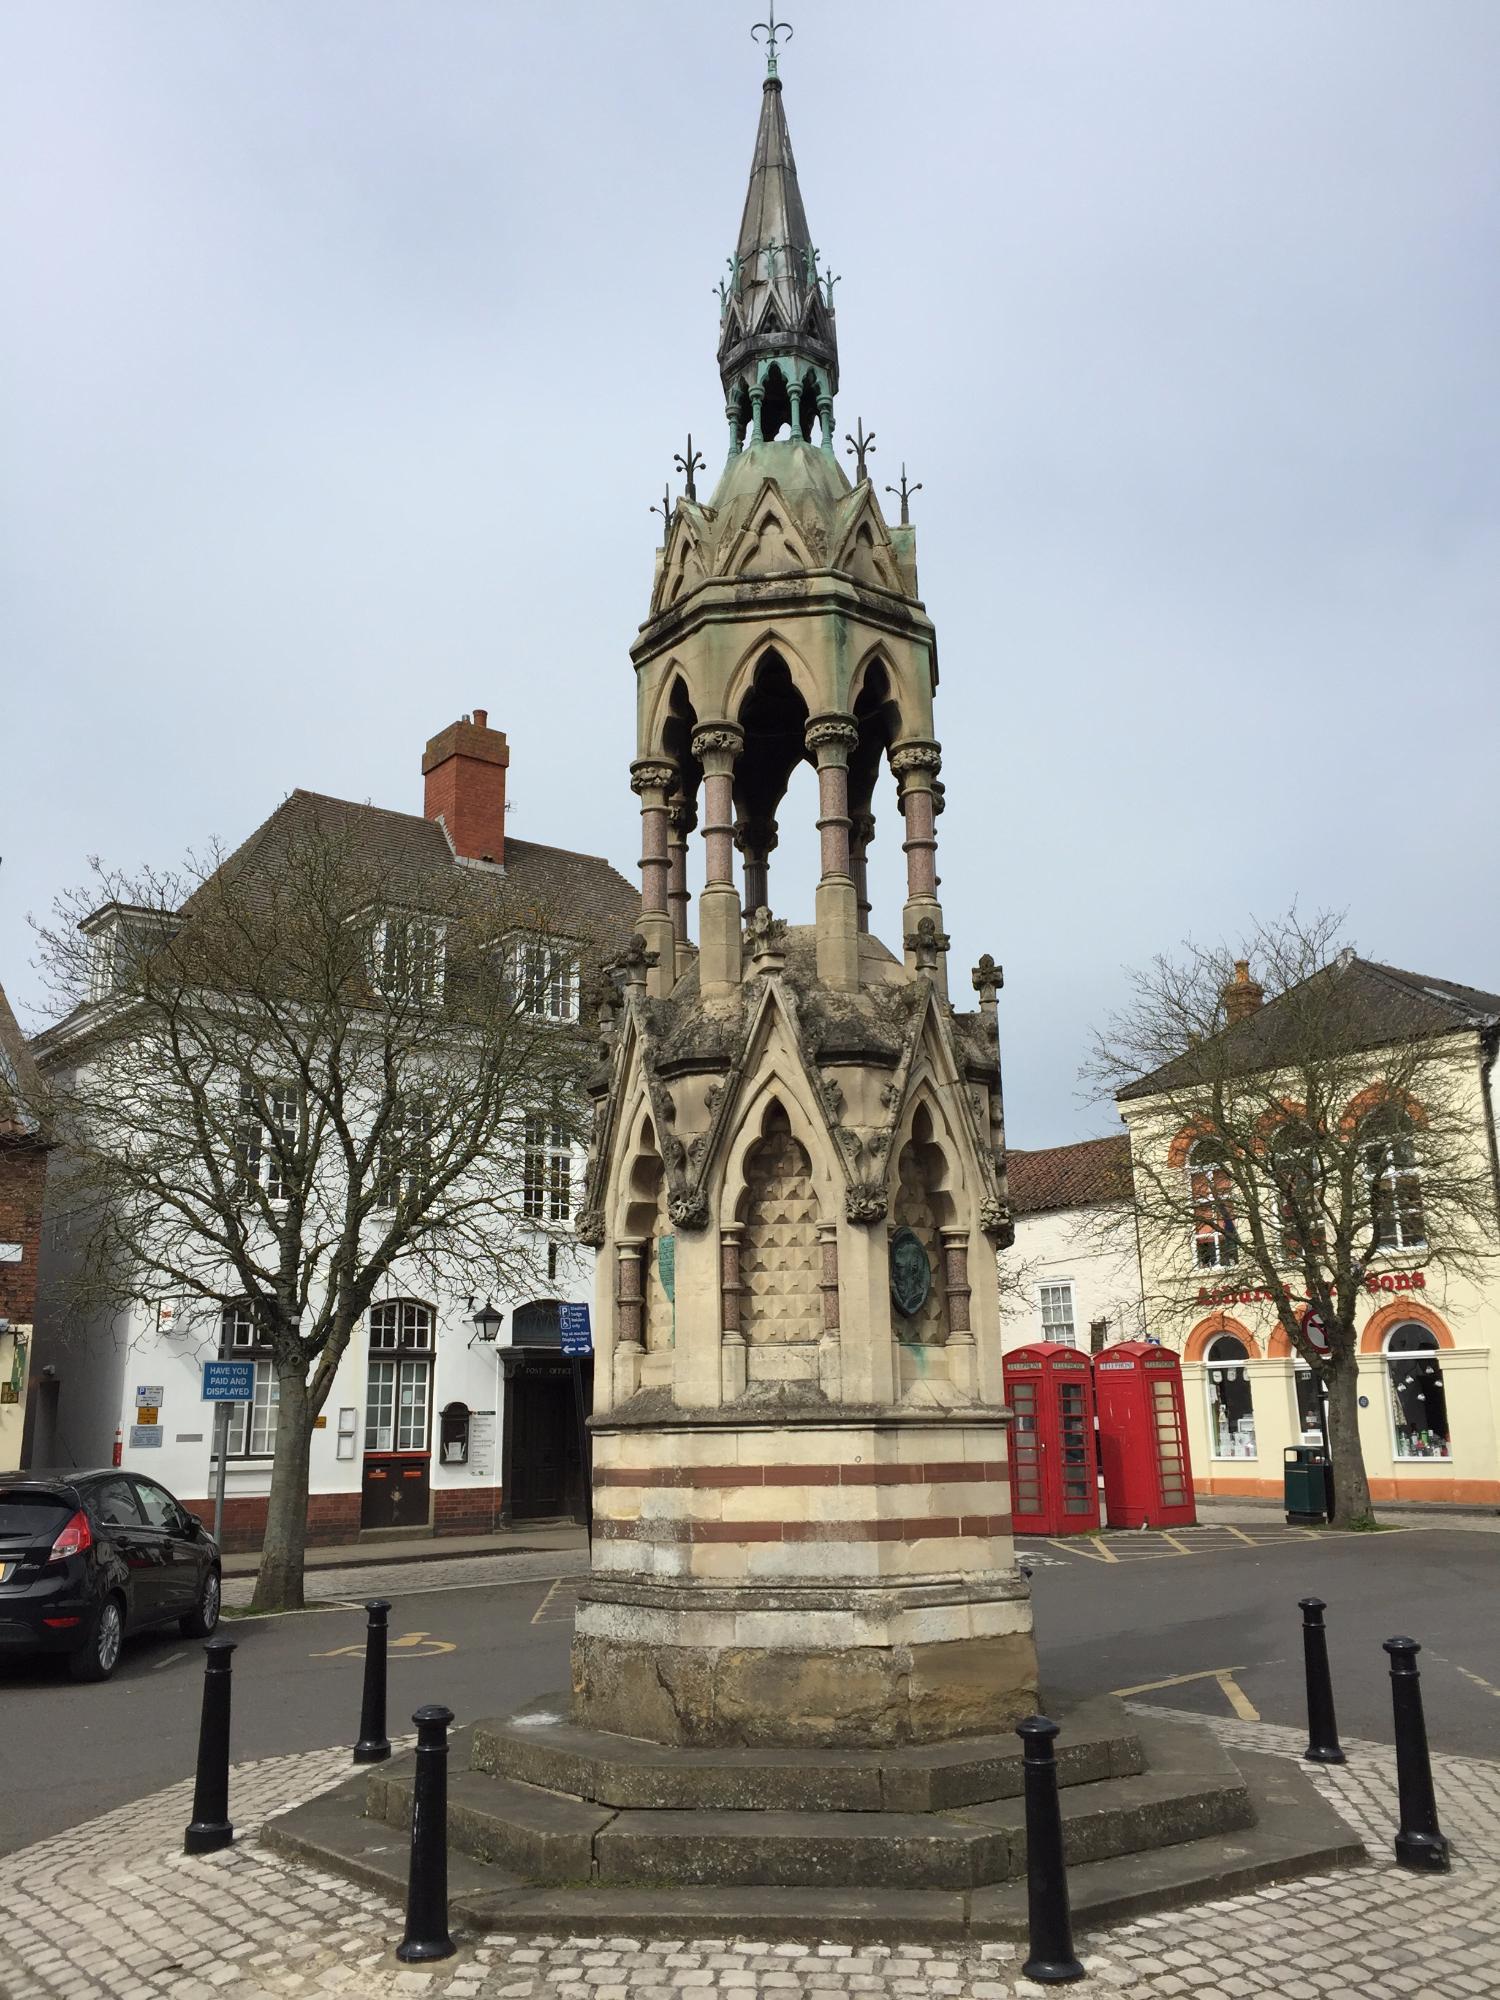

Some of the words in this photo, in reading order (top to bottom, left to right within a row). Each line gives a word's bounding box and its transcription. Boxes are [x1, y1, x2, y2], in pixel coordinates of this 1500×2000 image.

[210, 1367, 230, 1375] HAVE
[232, 1367, 249, 1375] YOU
[526, 1367, 542, 1375] POST
[210, 1377, 229, 1385] PAID
[230, 1377, 247, 1385] AND
[206, 1387, 250, 1396] DISPLAYED
